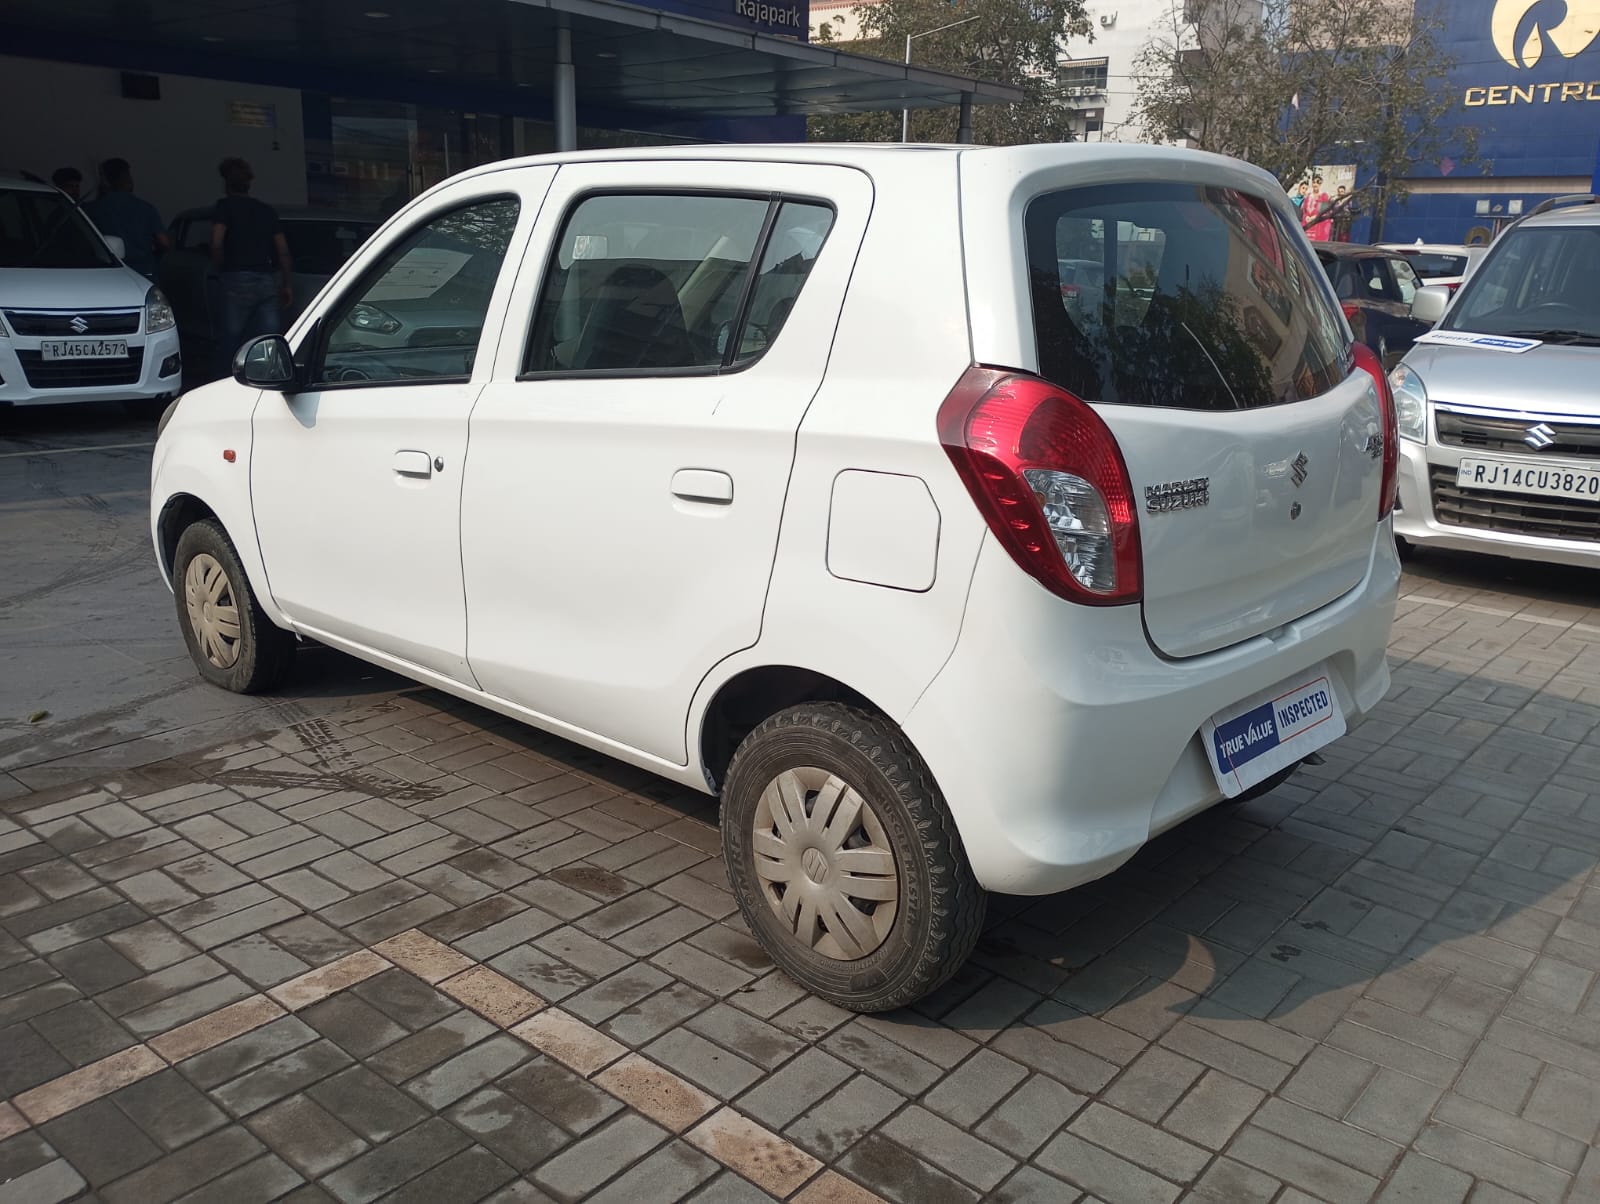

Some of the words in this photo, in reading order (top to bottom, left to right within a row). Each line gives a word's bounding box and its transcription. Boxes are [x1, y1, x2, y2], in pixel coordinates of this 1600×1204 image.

[735, 0, 801, 28] Rajapark
[53, 344, 126, 357] RJ45CA2573
[1144, 477, 1210, 499] MARUTI
[1475, 465, 1600, 494] RJ14CU3820
[1146, 491, 1210, 514] SUZUKI
[1278, 690, 1329, 728] INSPECTED
[1219, 735, 1245, 759] TRUE
[1242, 719, 1274, 747] VALUE
